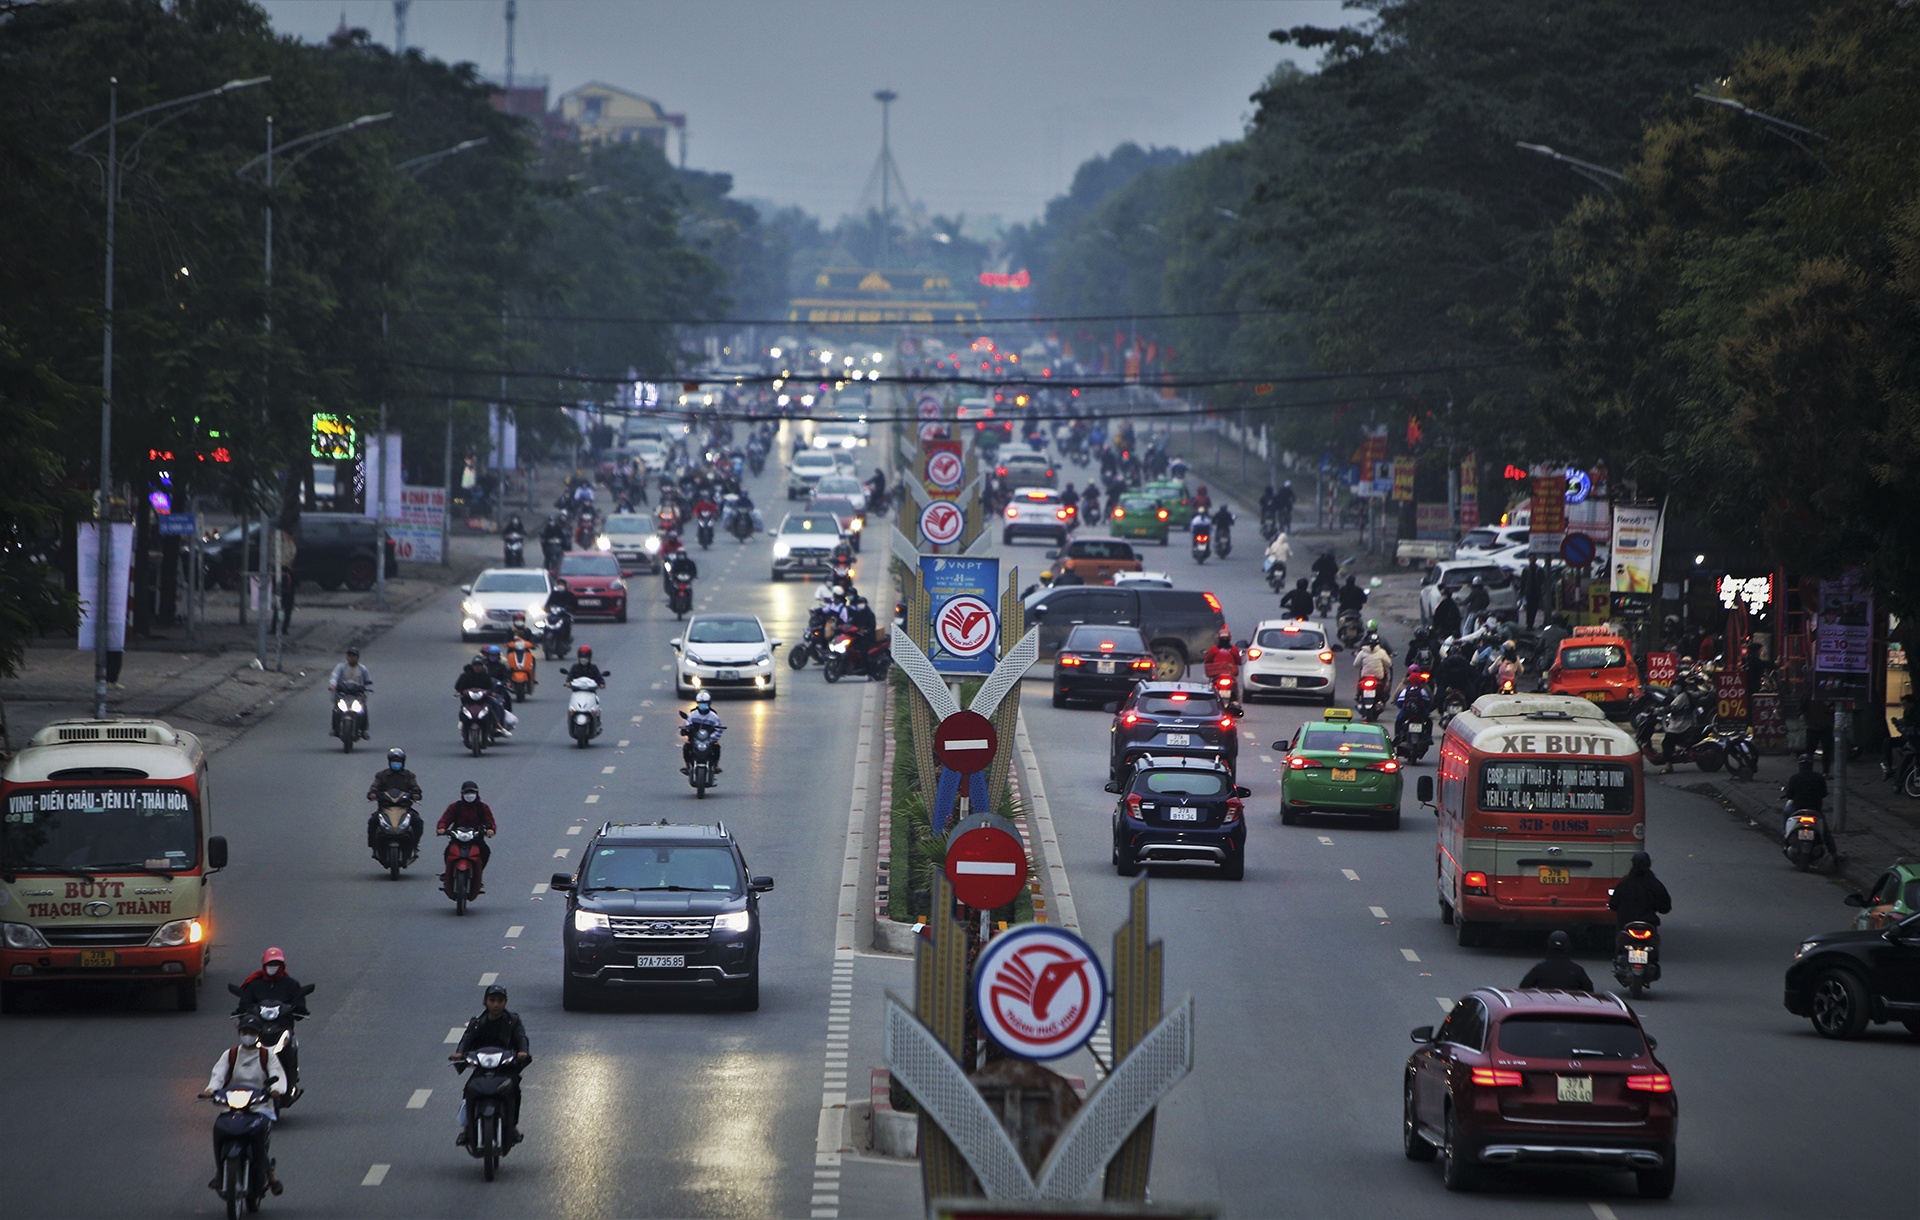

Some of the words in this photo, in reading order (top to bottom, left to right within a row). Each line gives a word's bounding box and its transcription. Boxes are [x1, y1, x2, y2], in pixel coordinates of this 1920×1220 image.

[948, 562, 982, 570] VNPT
[1833, 640, 1848, 649] 10
[1651, 654, 1673, 667] TRẢ
[1649, 668, 1675, 680] GÓP
[1719, 673, 1742, 685] TRẢ
[1718, 688, 1745, 699] GÓP
[1718, 699, 1747, 717] 0%
[1502, 735, 1536, 753] XE
[1546, 734, 1614, 755] BUÝT
[1527, 766, 1546, 787] THUẬT
[1546, 769, 1552, 785] 3
[1610, 771, 1624, 787] VINH
[9, 795, 33, 813] VINH
[40, 789, 64, 810] DIỄN
[67, 789, 94, 810] CHÂU
[101, 789, 121, 809] YÊN
[124, 789, 136, 809] LÝ
[142, 788, 164, 810] THÁI
[167, 789, 188, 810] HÒA
[1486, 788, 1499, 806] YÊN
[1512, 791, 1520, 808] QL
[1535, 789, 1551, 808] THÁI
[1551, 789, 1566, 808] HÒA
[1519, 818, 1543, 831] 37B
[1552, 819, 1588, 832] 01863
[65, 879, 125, 898] BUÝT
[135, 887, 173, 896] COUNTY
[28, 902, 82, 919] THẠCH
[116, 898, 172, 916] THÀNH
[90, 951, 106, 959] 37B
[84, 959, 112, 967] 015.53
[637, 956, 684, 967] 37A-735.85
[1566, 1078, 1585, 1089] 37A
